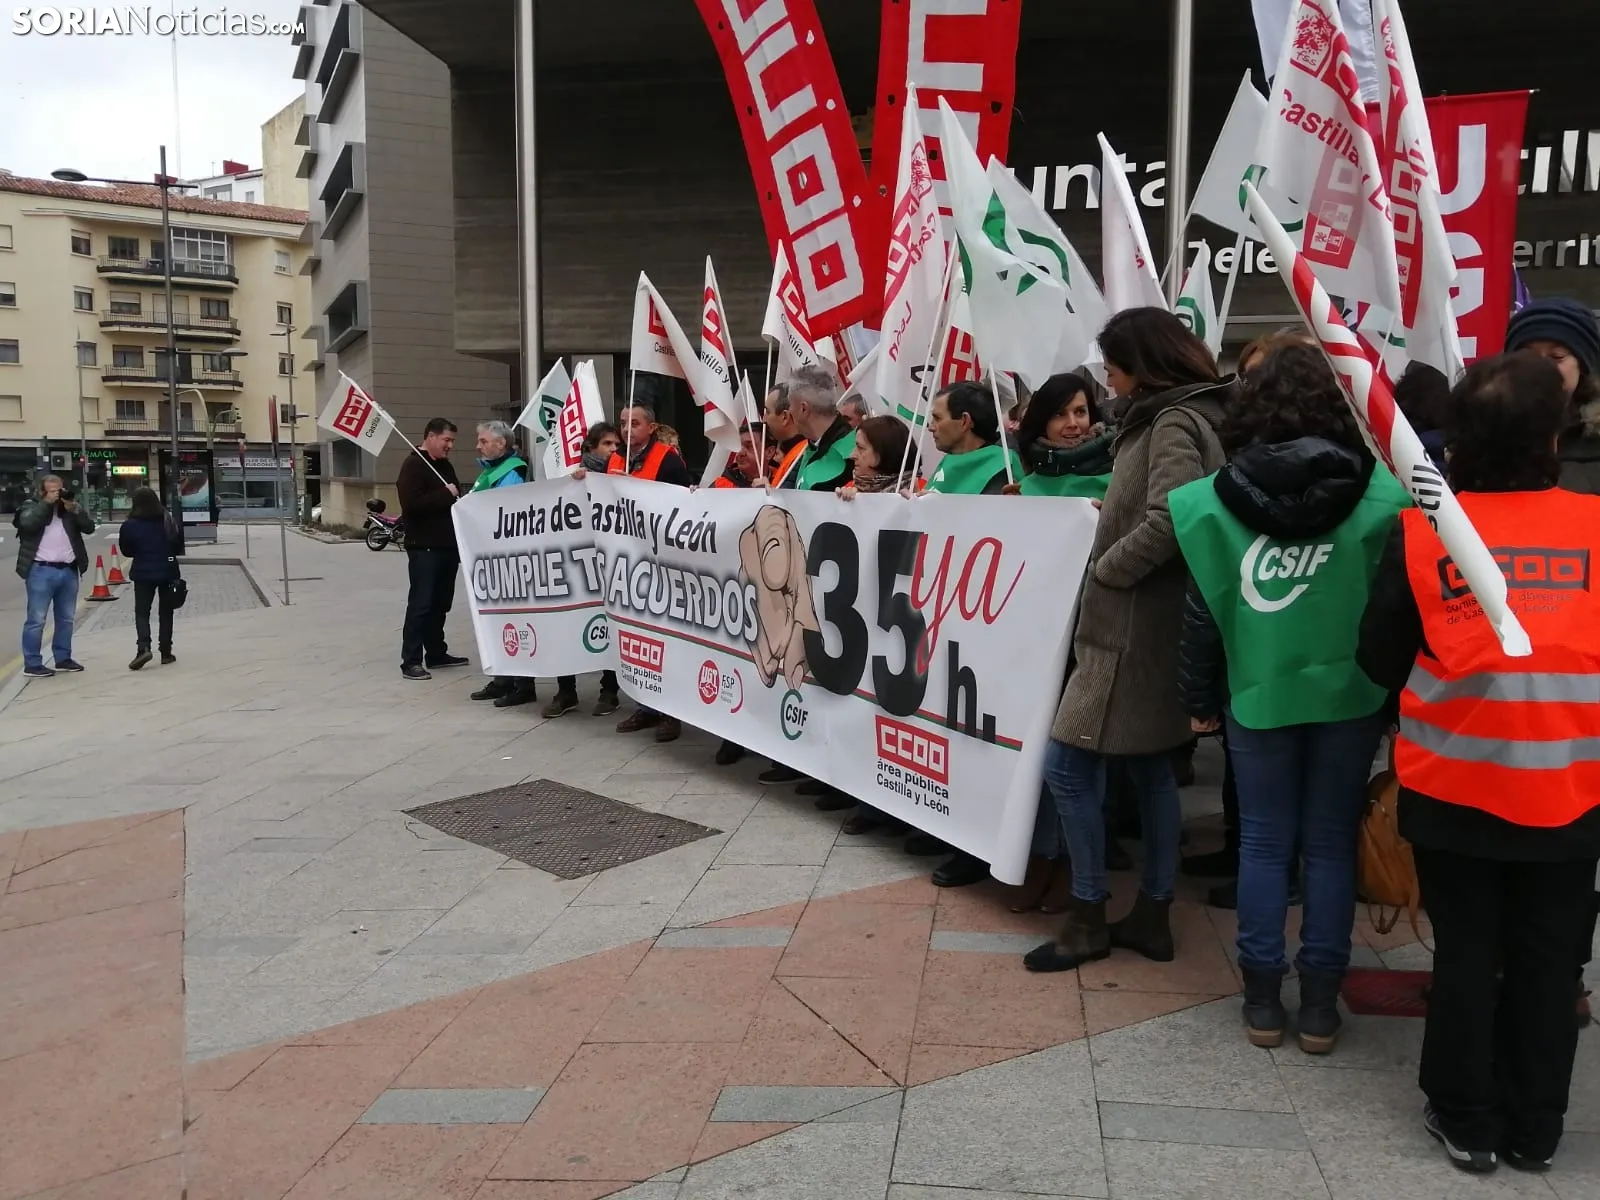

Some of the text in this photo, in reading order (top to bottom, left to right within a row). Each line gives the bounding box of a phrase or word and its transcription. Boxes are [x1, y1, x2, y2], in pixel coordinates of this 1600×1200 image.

[493, 492, 718, 556] Junta de astilla y León
[1258, 544, 1335, 580] CSIF
[473, 551, 569, 601] CUMPLE
[609, 556, 758, 642] ACUERDOS
[590, 625, 610, 641] CSI
[803, 521, 1025, 717] 35 ya
[620, 635, 662, 667] CCOO
[785, 703, 809, 727] CSIF
[881, 723, 945, 776] CCOO
[876, 773, 912, 799] Castilla
[923, 793, 950, 817] León
[877, 758, 949, 800] área pública
